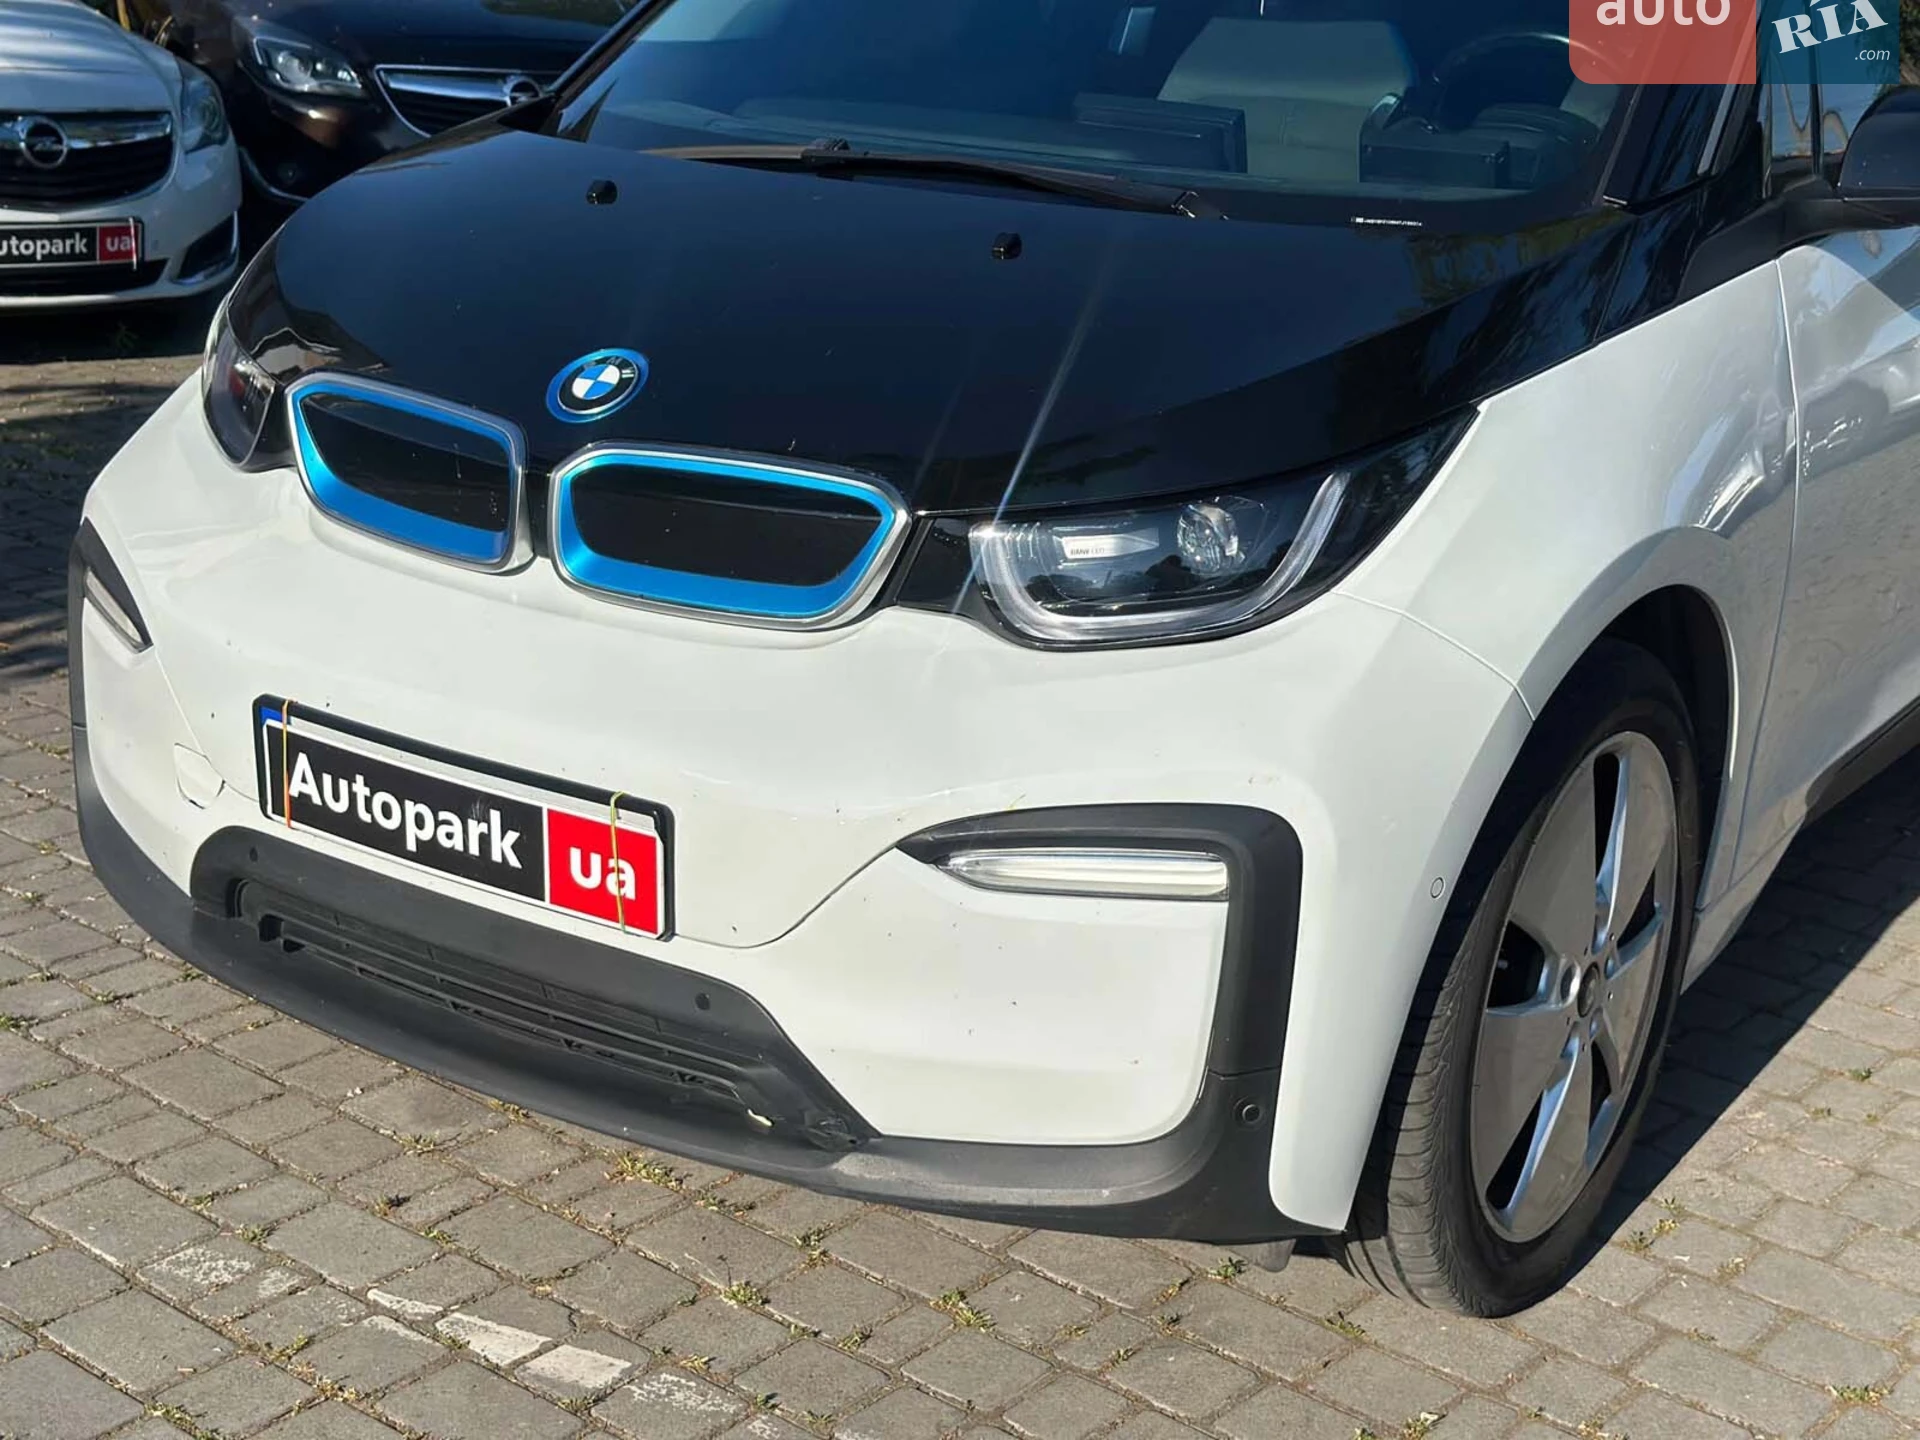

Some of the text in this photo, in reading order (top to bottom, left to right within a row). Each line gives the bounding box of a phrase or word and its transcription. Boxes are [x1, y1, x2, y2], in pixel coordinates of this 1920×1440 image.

[106, 236, 132, 252] ua
[289, 752, 637, 901] Autopark ua
